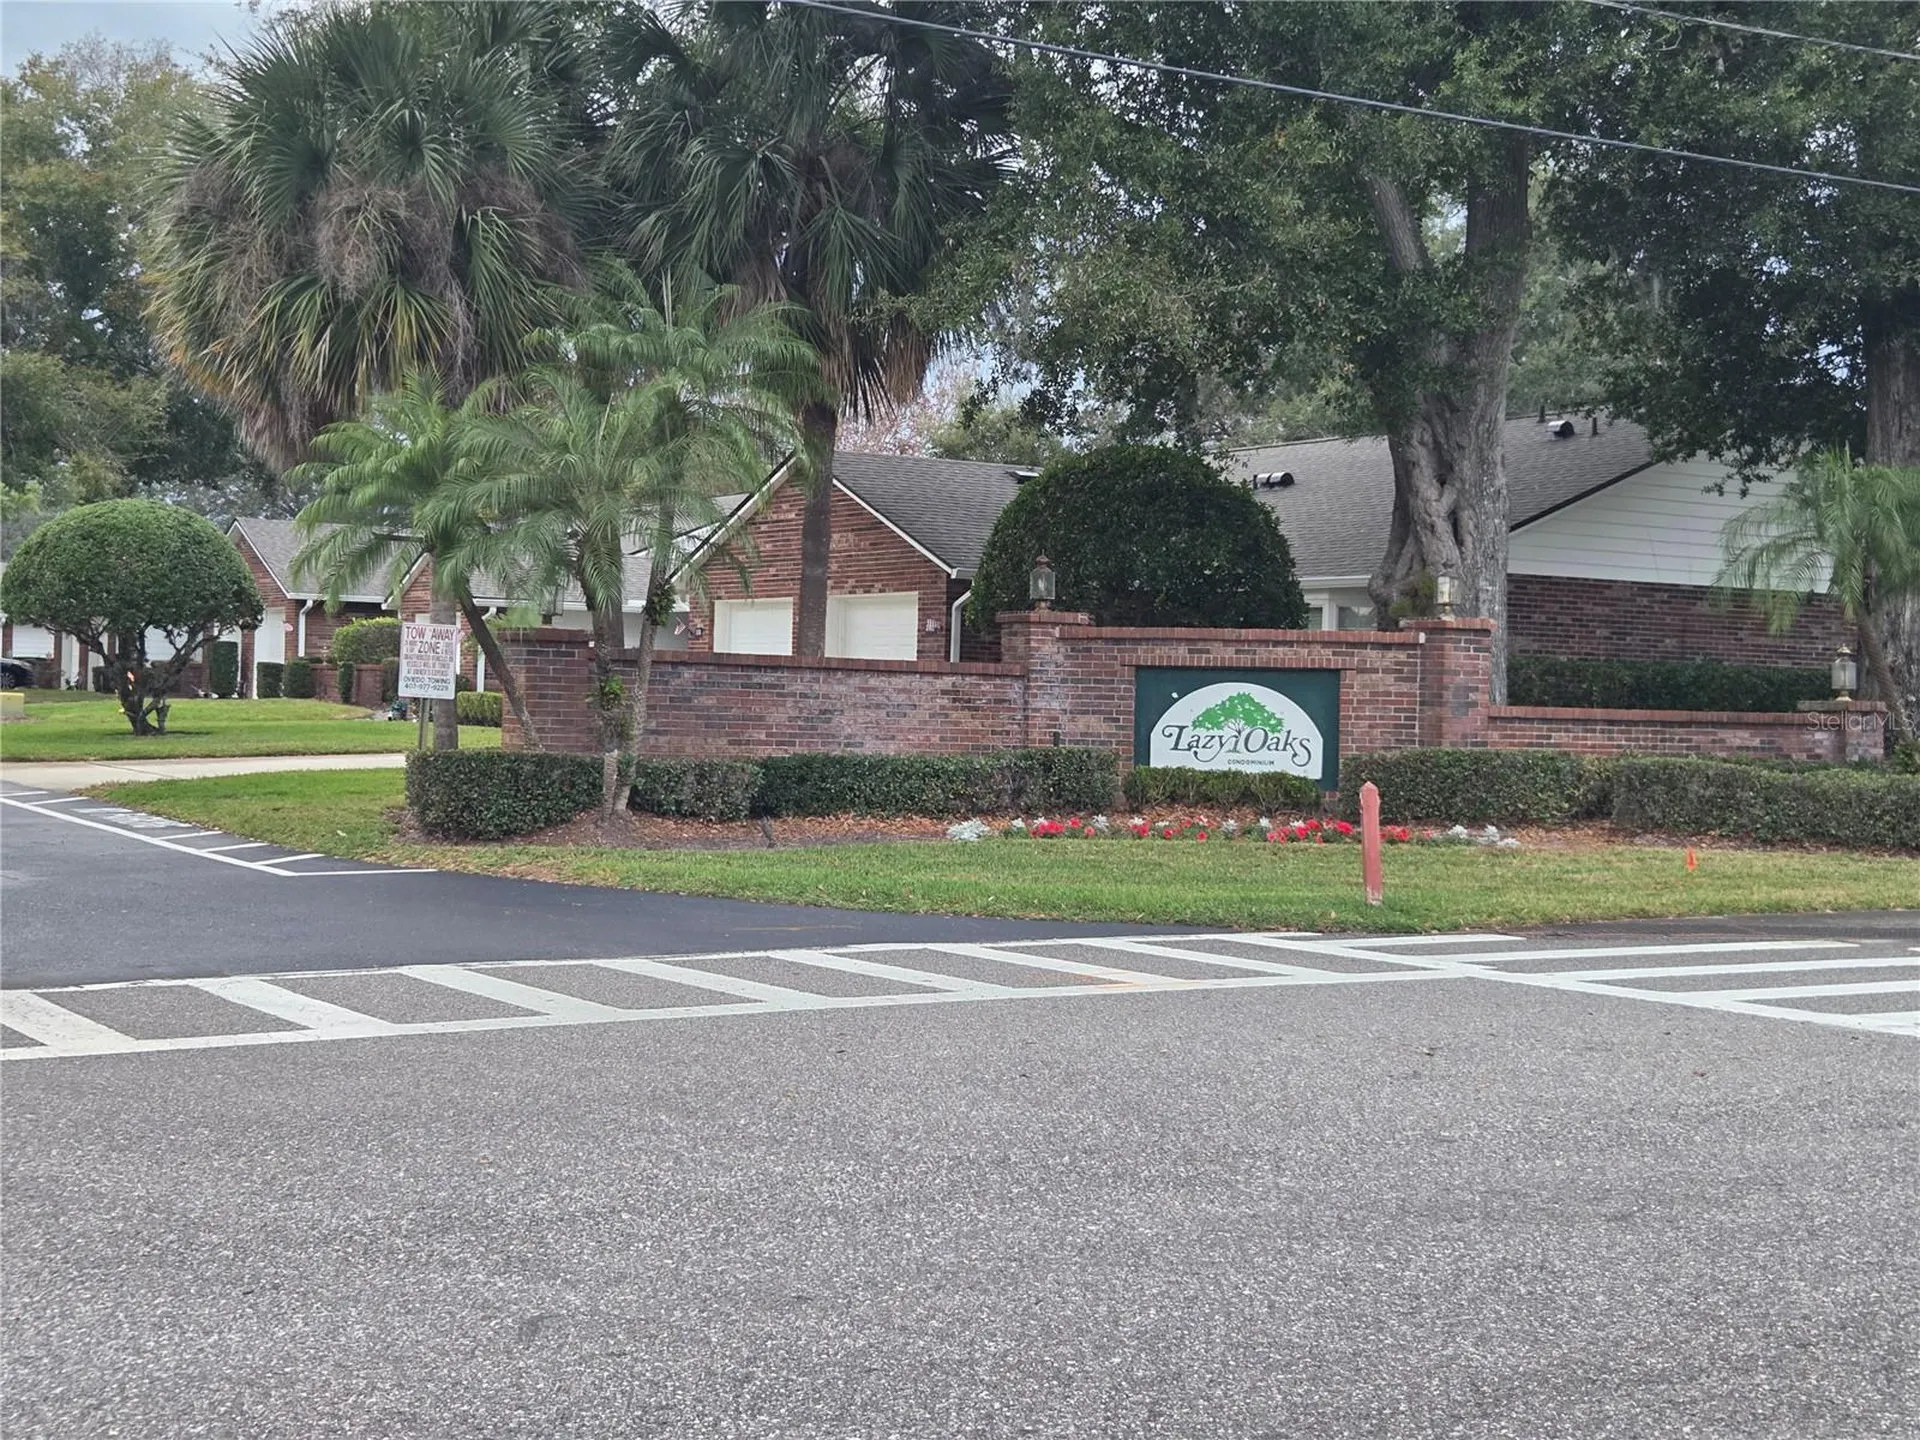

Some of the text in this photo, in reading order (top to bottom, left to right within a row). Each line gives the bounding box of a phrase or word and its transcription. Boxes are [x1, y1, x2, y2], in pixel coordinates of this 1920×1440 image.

[406, 626, 455, 641] TOW AWAY
[418, 641, 441, 654] ZONE
[427, 677, 451, 685] TOWING
[1162, 724, 1312, 767] Lazy Oaks
